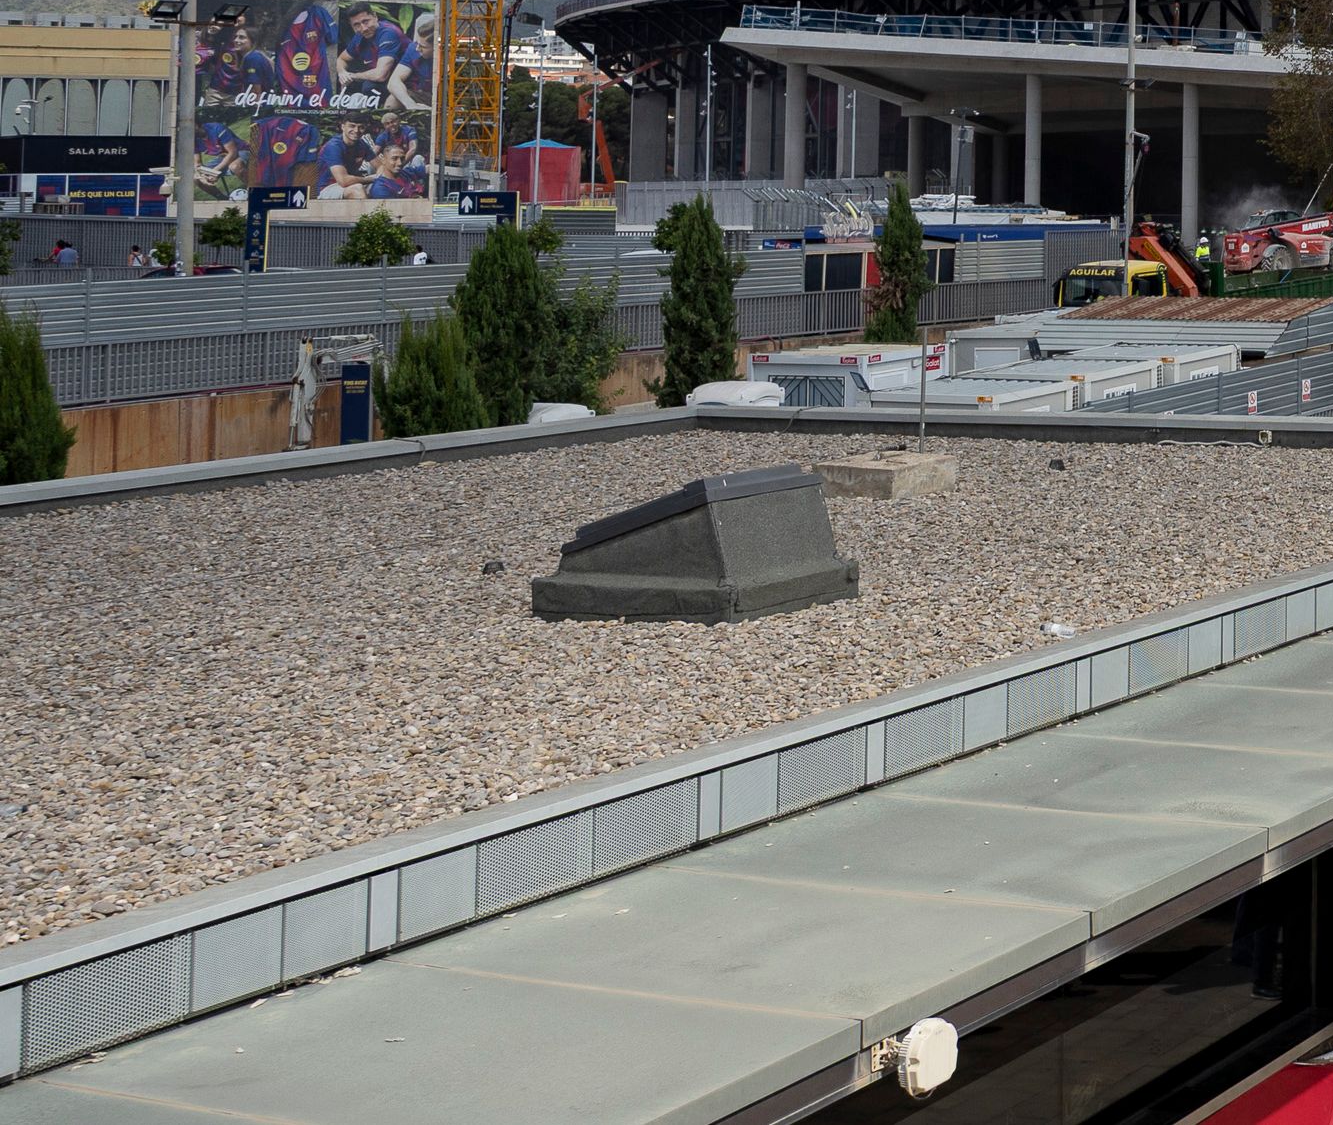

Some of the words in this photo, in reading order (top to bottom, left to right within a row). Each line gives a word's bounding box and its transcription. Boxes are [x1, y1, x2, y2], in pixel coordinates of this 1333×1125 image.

[235, 84, 303, 117] definim
[309, 88, 327, 108] el
[329, 86, 381, 109] demà
[69, 147, 95, 155] SALA
[98, 146, 128, 155] PARÍS
[69, 190, 86, 198] MÉS
[88, 191, 102, 199] QUE
[116, 190, 135, 198] CLUB
[1069, 268, 1116, 276] AGUILAR
